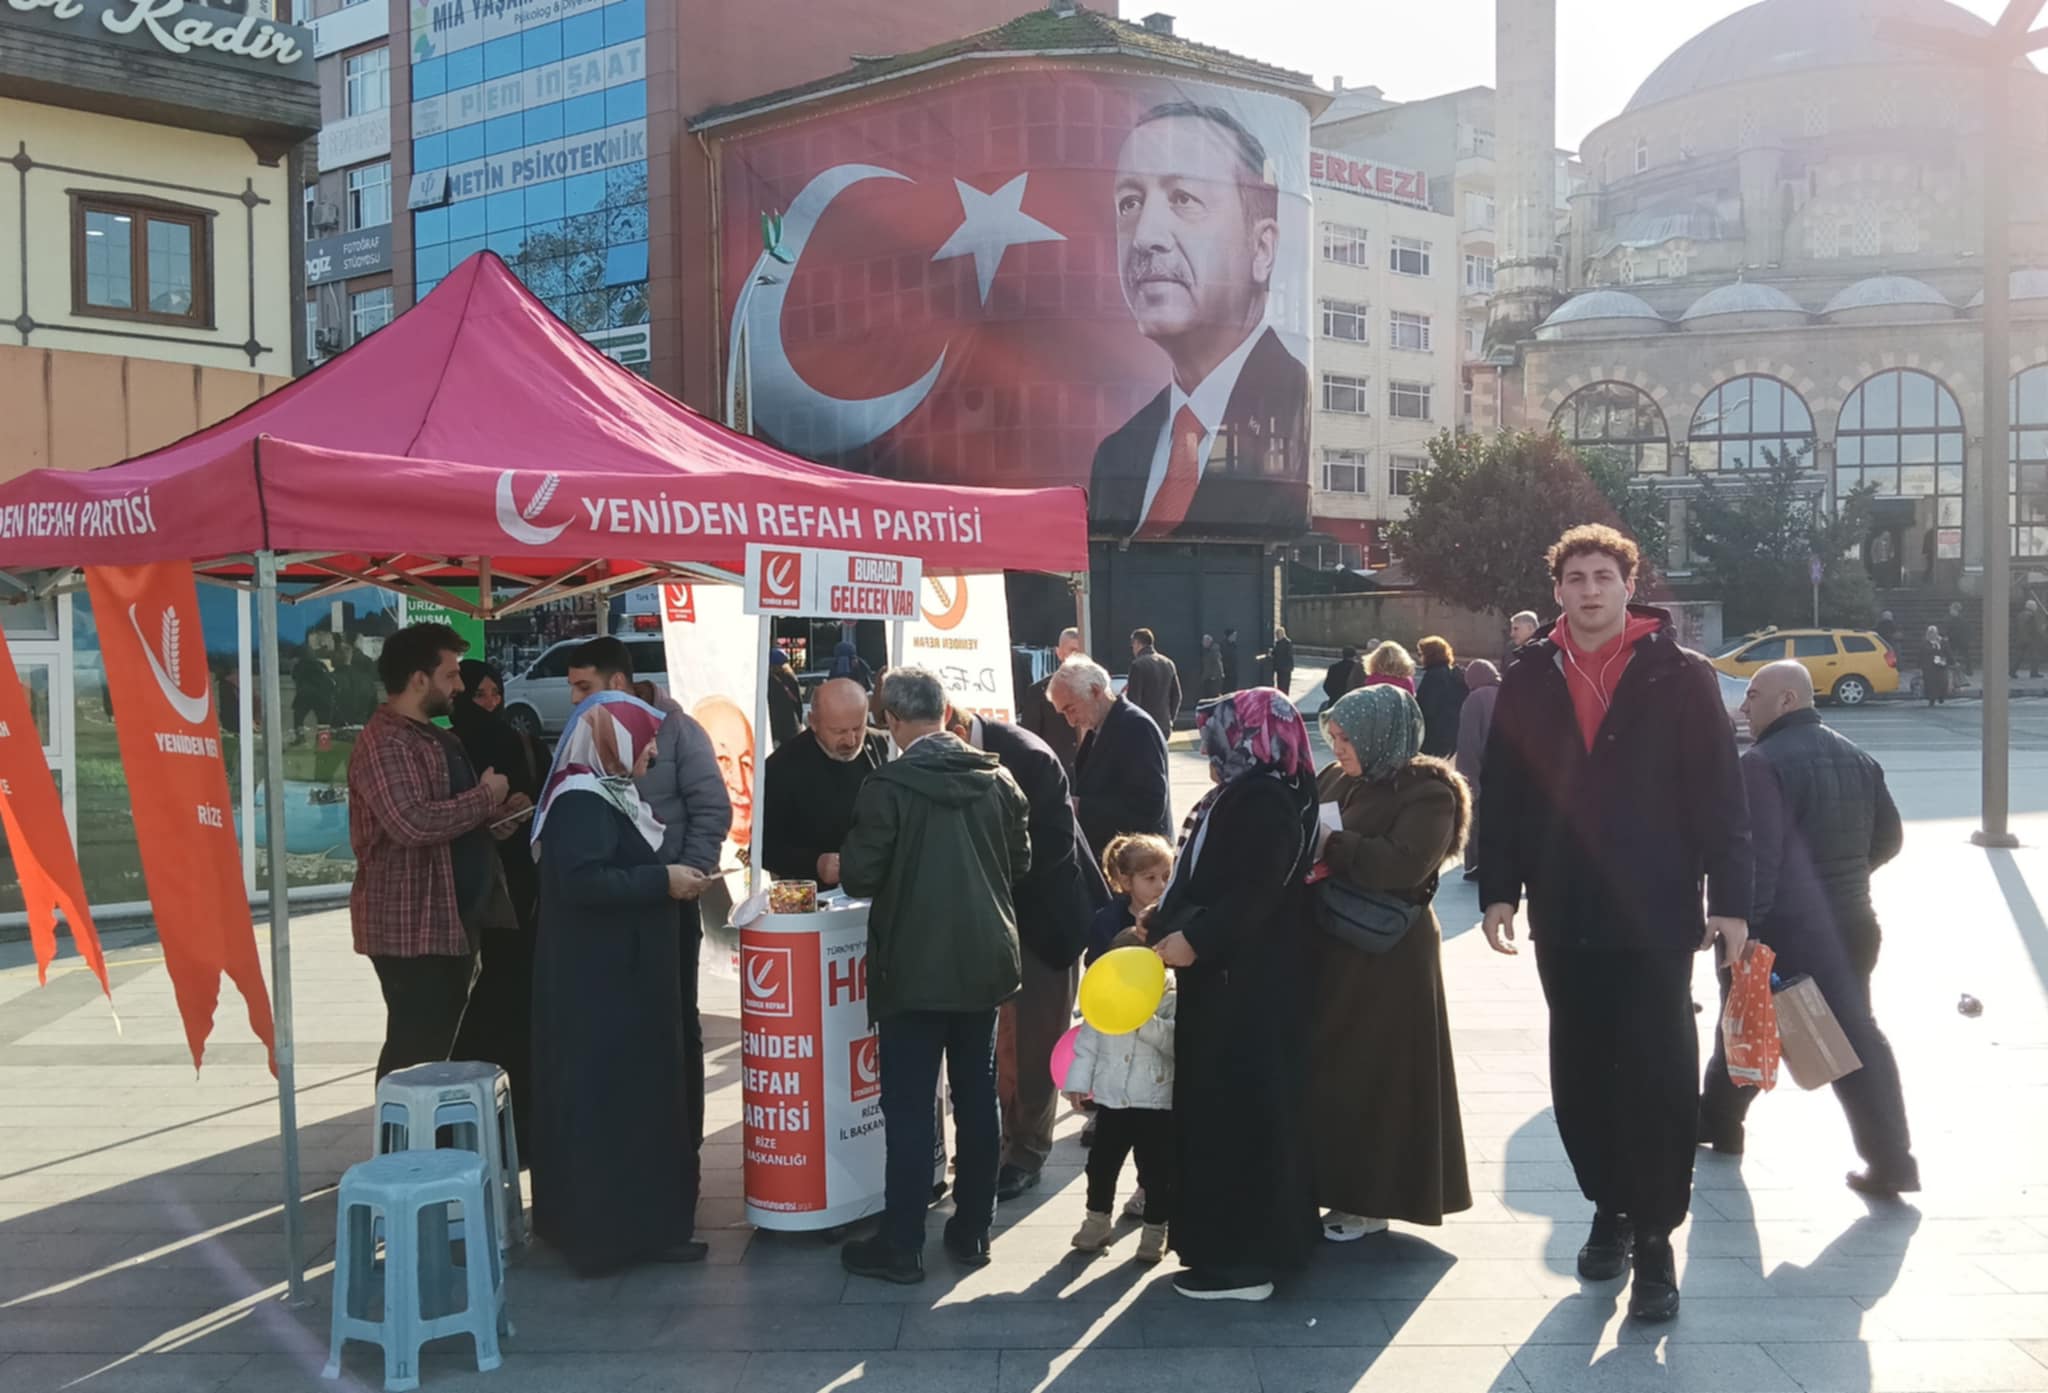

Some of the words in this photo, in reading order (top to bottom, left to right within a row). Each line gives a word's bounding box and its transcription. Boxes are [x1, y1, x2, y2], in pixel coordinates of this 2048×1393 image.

[101, 0, 303, 64] Kadir
[512, 128, 645, 185] PSİKOTEKNİK
[27, 502, 78, 537] REFAH
[80, 487, 157, 537] PARTİSİ
[581, 492, 749, 535] YENİDEN
[757, 502, 862, 539] REFAH
[873, 506, 982, 544] PARTİSİ
[854, 558, 898, 584] BURADA
[831, 585, 890, 615] GELECEK
[892, 590, 914, 616] VAR
[154, 729, 206, 756] YENİDEN
[197, 801, 223, 828] RİZE
[755, 1135, 777, 1150] RİZE
